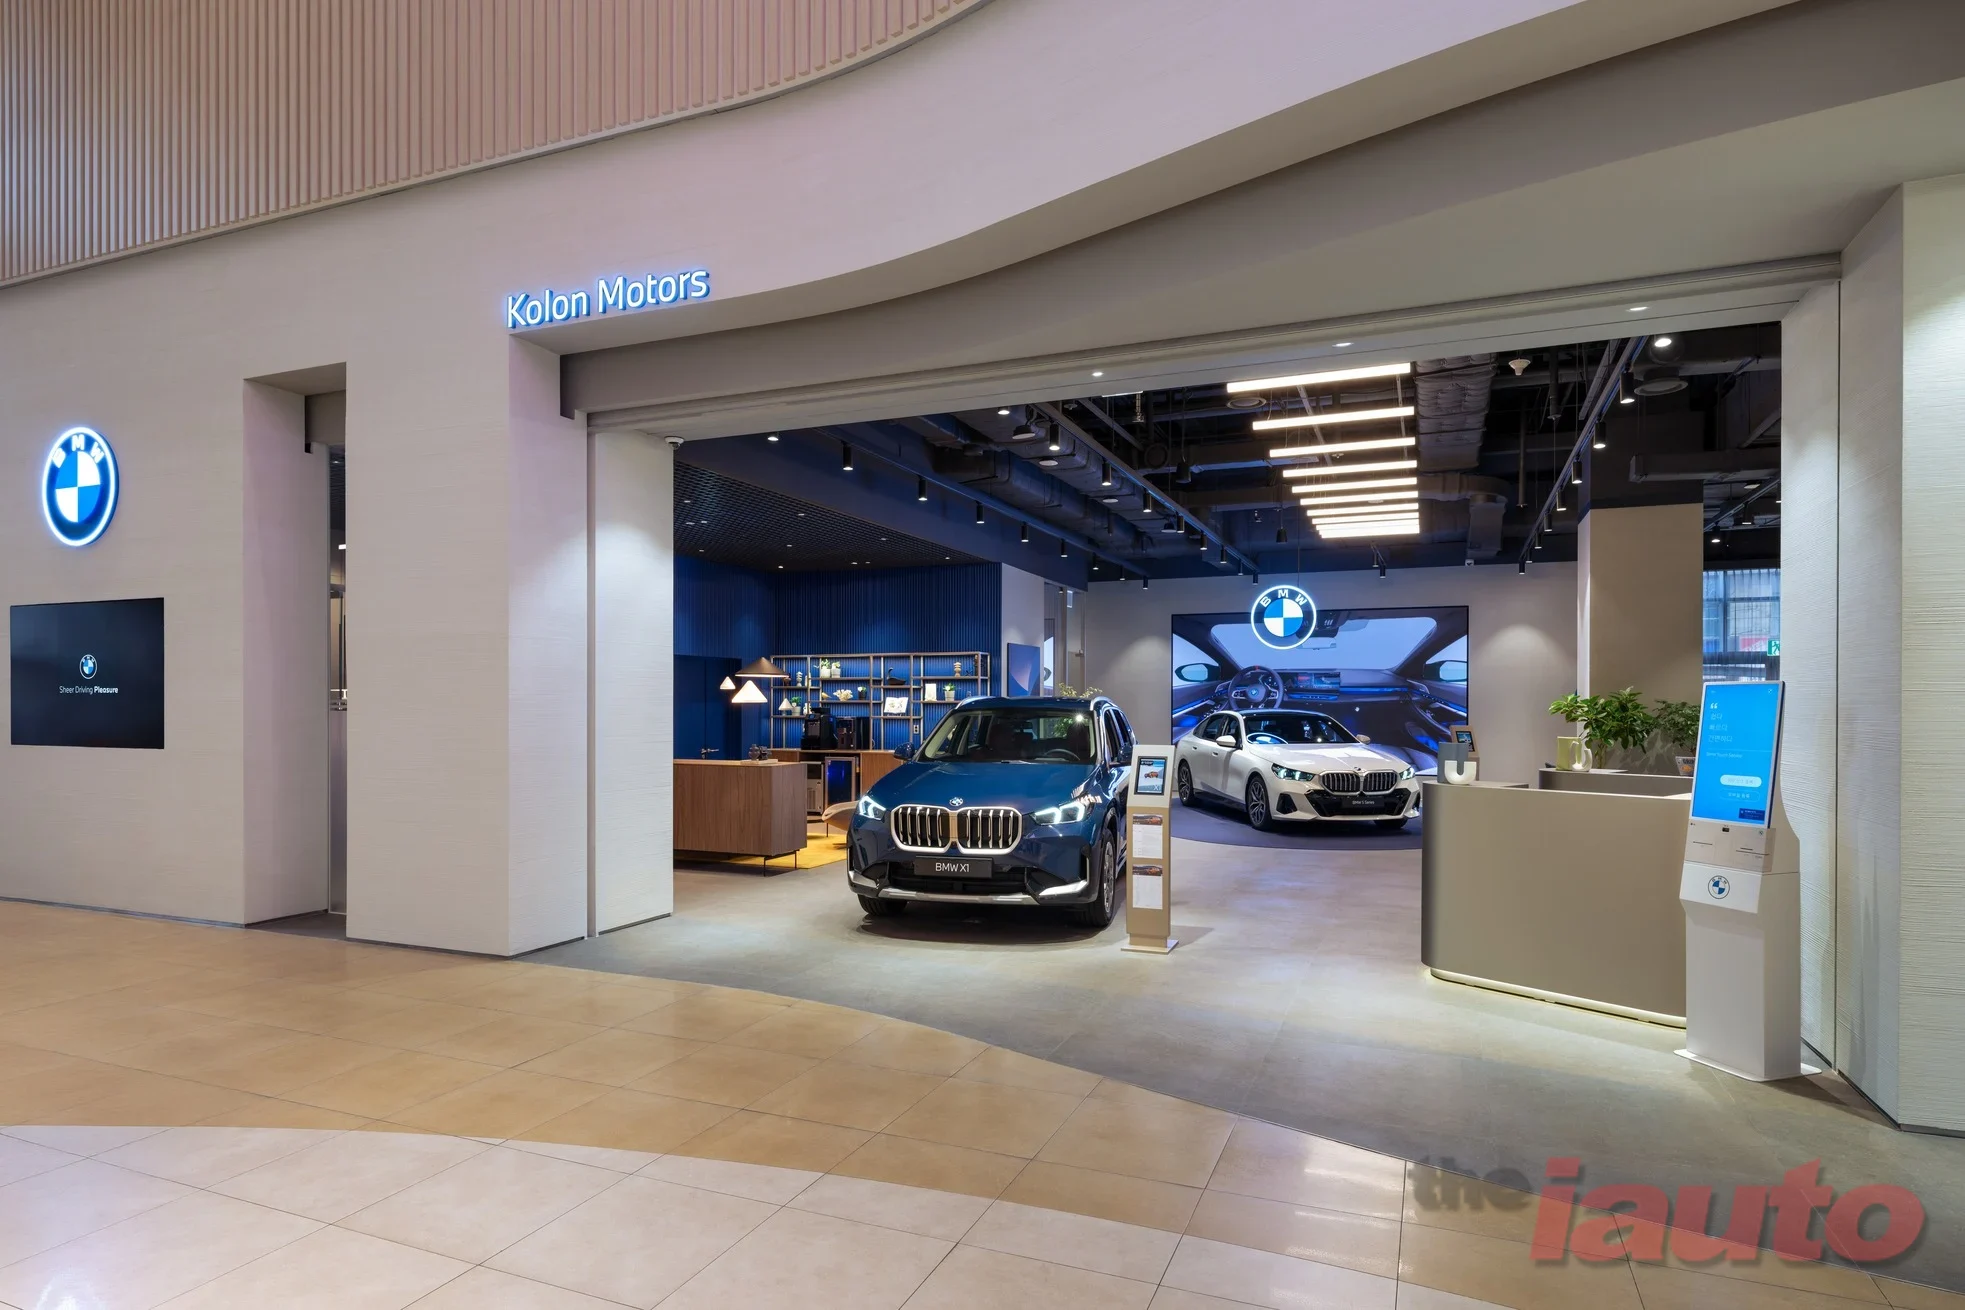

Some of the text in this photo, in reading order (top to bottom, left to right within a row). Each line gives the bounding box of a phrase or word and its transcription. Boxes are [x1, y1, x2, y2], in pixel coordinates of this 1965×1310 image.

[507, 270, 709, 328] Kolon Motors
[52, 433, 105, 468] BMW
[1260, 589, 1307, 608] BMW
[59, 685, 119, 695] Sheer Driving Pleasure
[935, 862, 970, 873] BMW X1
